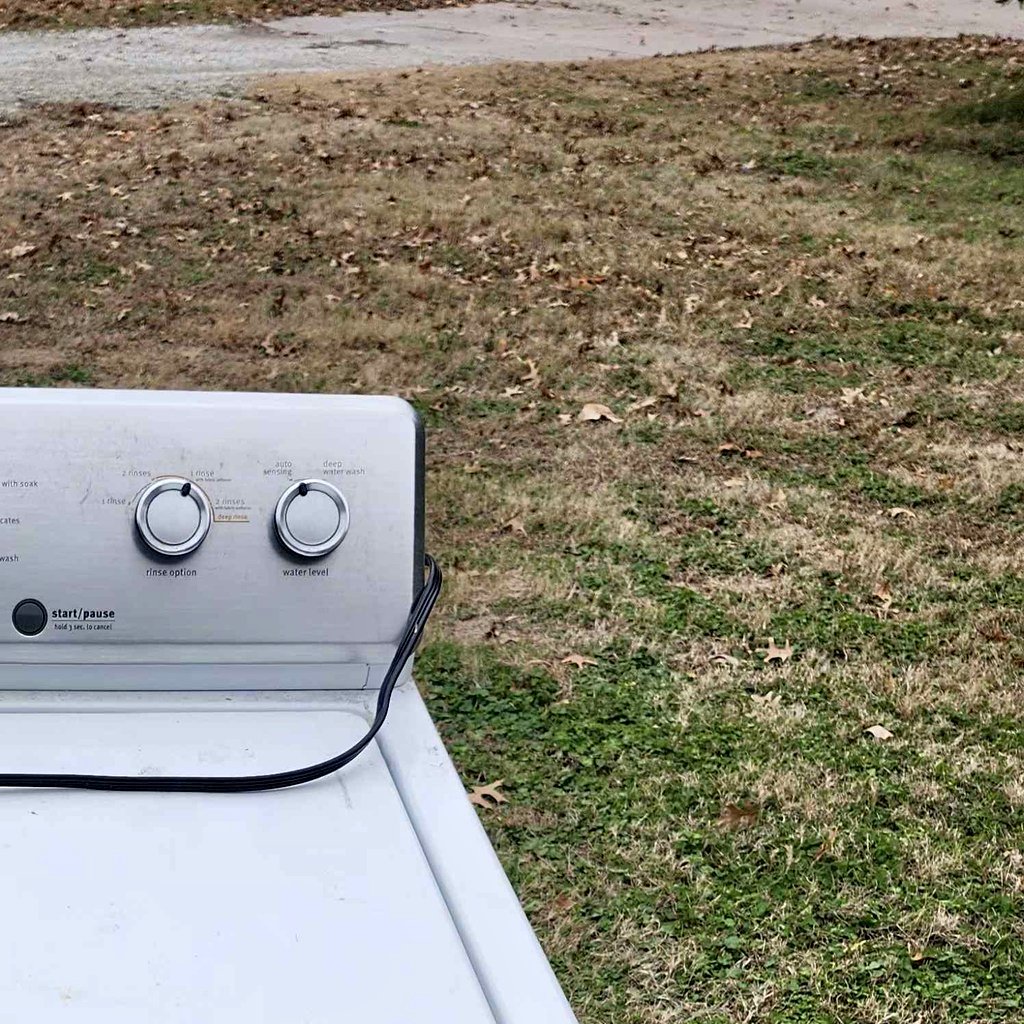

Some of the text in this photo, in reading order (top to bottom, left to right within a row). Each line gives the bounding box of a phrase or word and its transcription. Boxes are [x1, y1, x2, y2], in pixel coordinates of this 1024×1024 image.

[275, 460, 292, 468] auto
[323, 460, 342, 470] deep
[129, 469, 151, 477] rinses
[263, 468, 293, 477] sensing
[346, 468, 365, 476] wash
[1, 480, 17, 488] with
[19, 480, 38, 488] soak
[107, 498, 126, 506] rinse
[222, 498, 246, 506] rinses
[1, 553, 19, 562] wash
[146, 568, 197, 578] rinse option
[282, 568, 329, 578] water level
[51, 606, 116, 621] start/pause
[54, 622, 68, 630] hold
[93, 622, 113, 630] cancel
